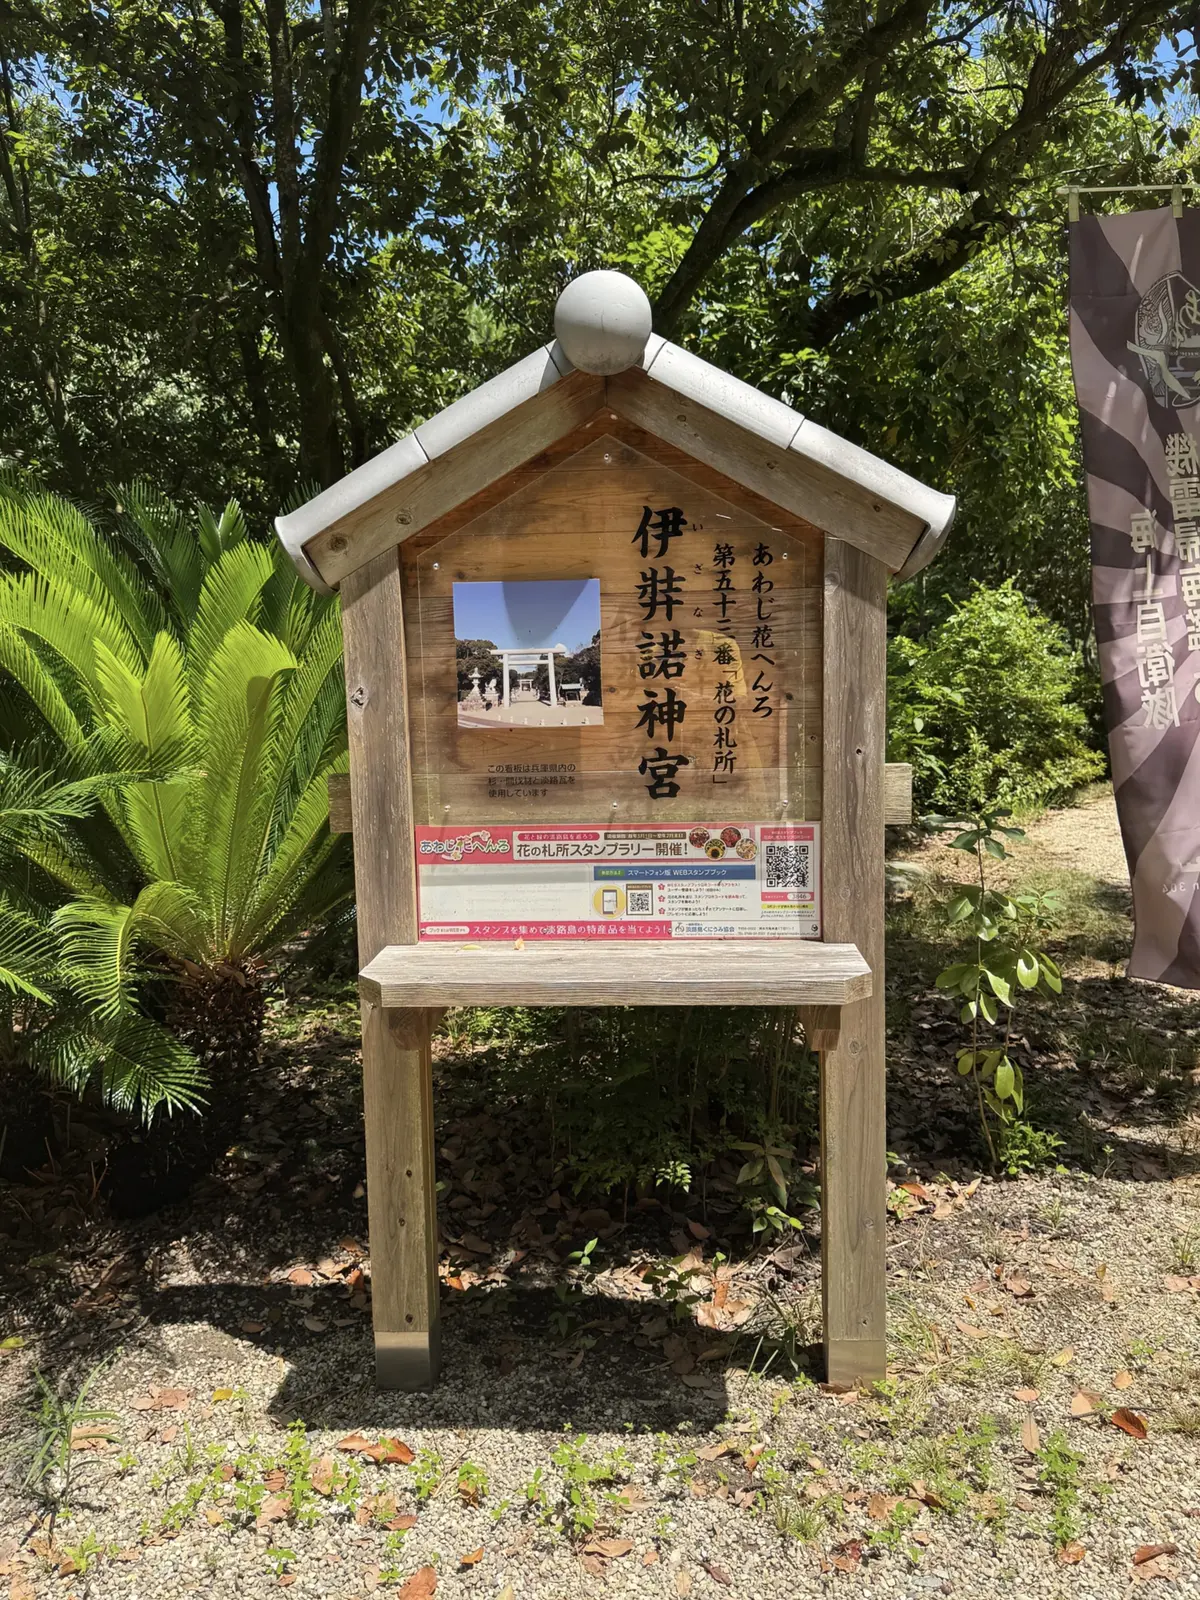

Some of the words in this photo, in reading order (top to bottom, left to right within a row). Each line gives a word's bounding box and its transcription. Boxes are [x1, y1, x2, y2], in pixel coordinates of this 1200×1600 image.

[711, 543, 738, 785] 第五十三番「花の札所」
[750, 541, 775, 719] あわじ花へんろ
[488, 788, 549, 798] 使用しています
